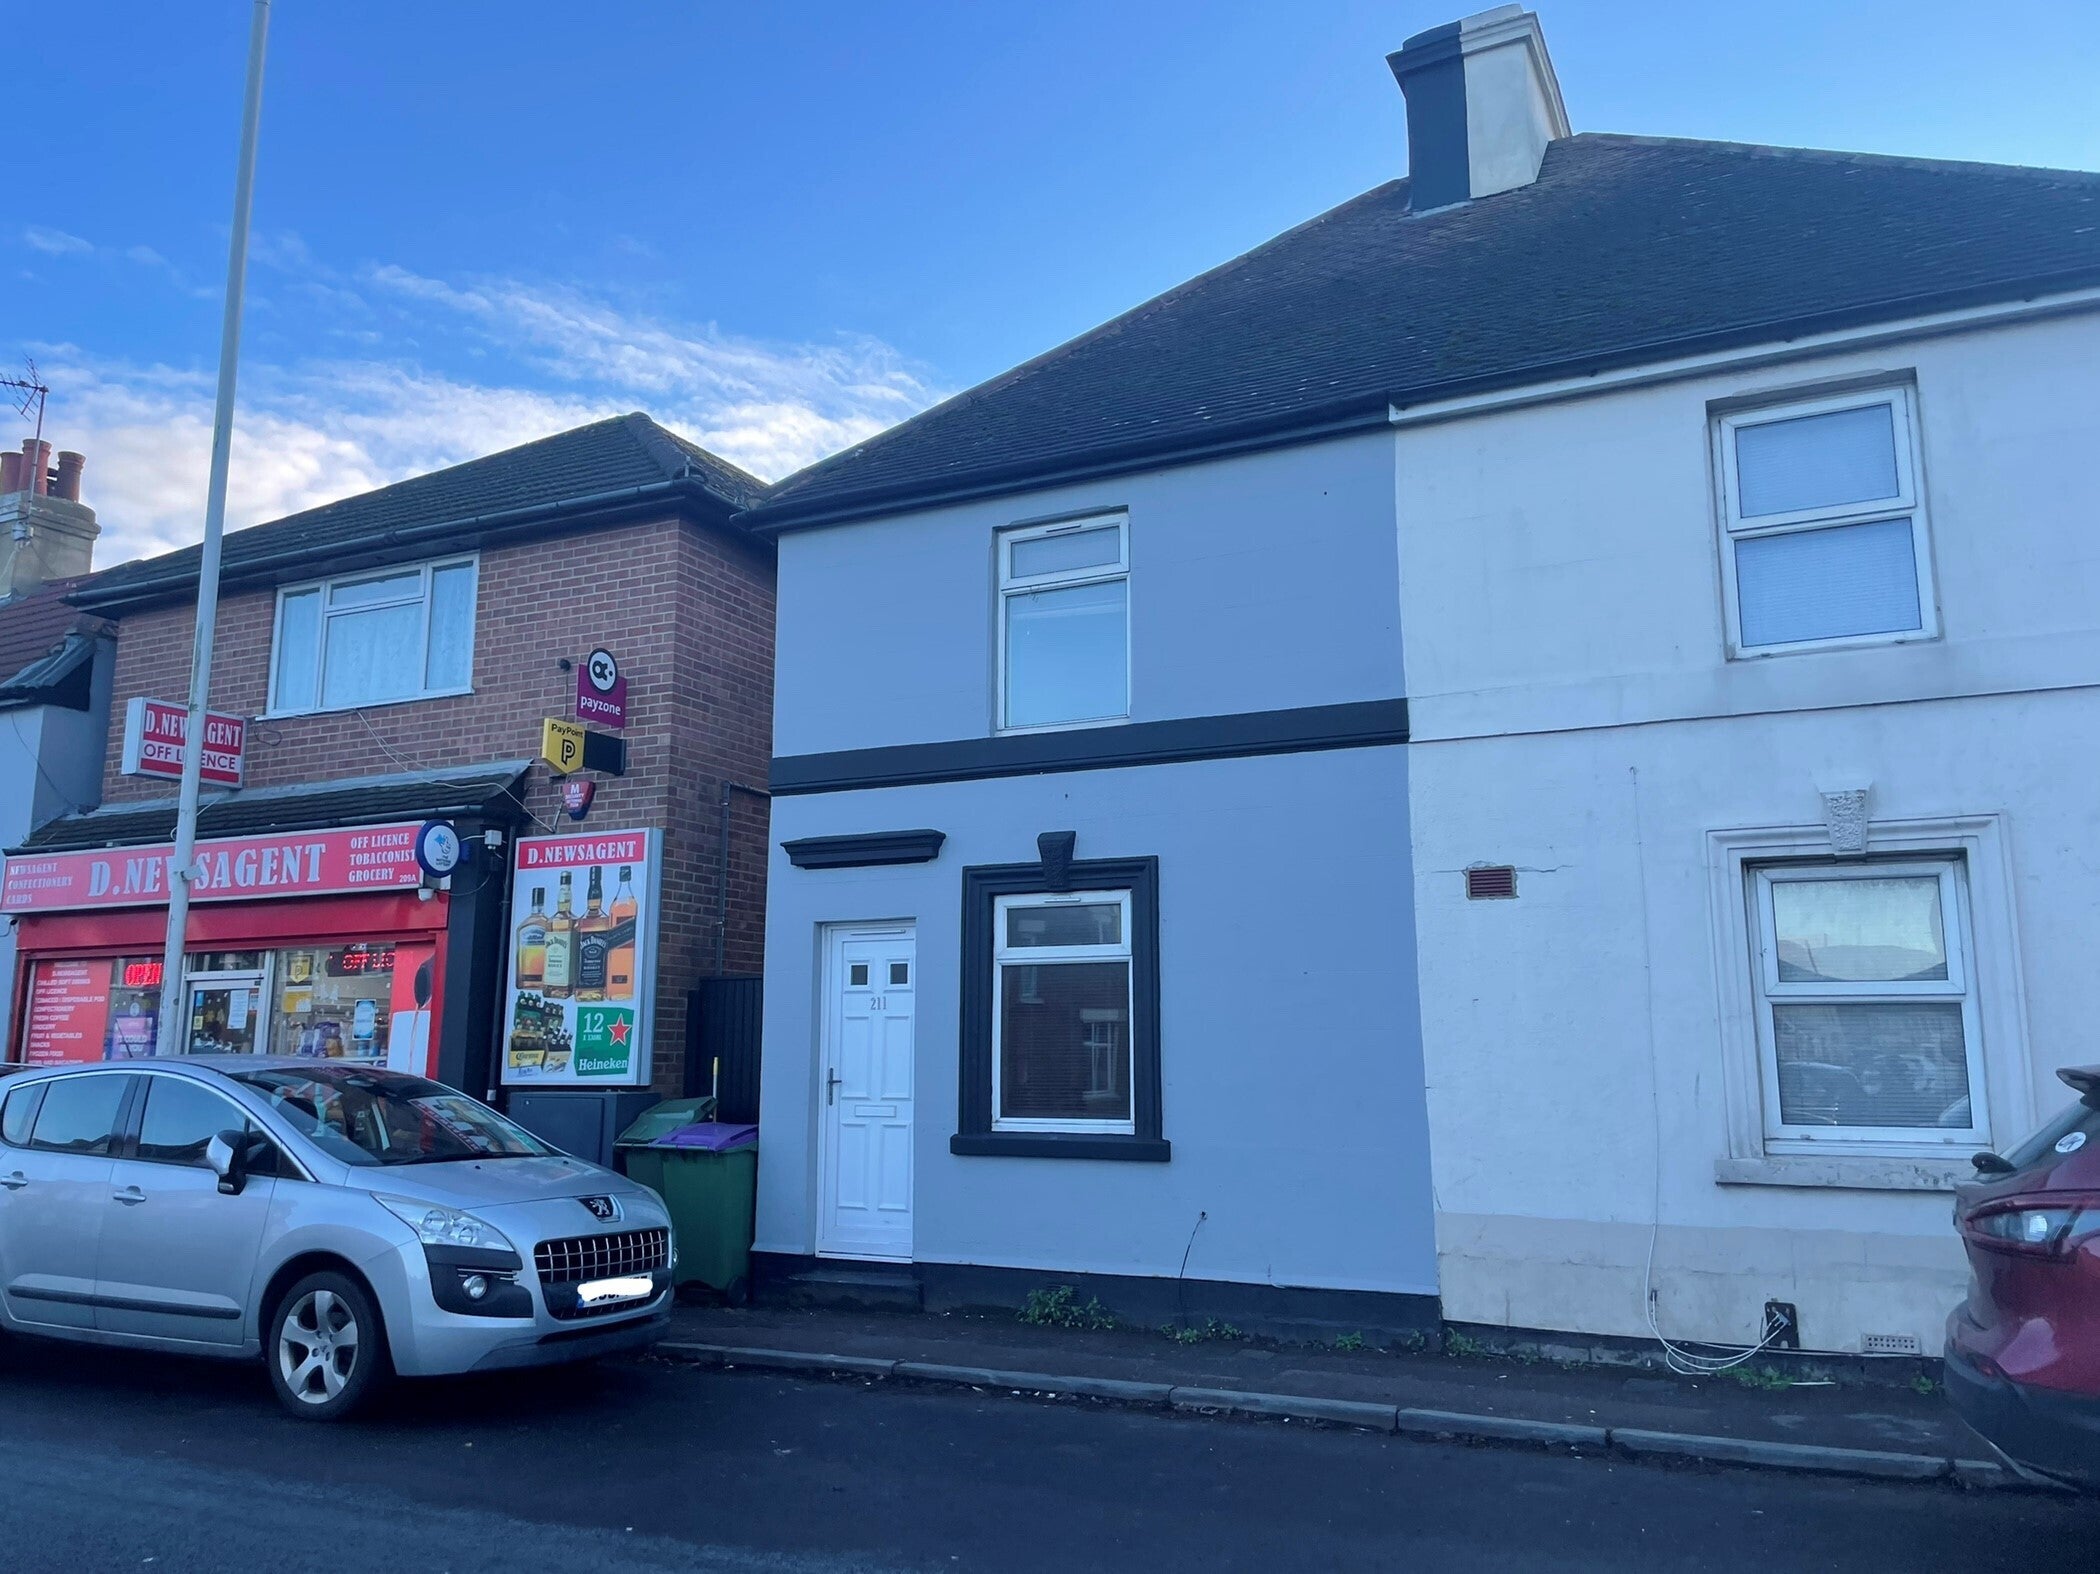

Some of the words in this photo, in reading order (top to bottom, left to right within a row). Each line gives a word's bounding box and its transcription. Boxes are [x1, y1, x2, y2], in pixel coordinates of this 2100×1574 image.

[580, 695, 622, 716] payzone
[551, 723, 584, 739] PayPoint
[144, 744, 172, 760] OFF
[561, 739, 576, 766] P
[350, 836, 369, 849] OFF
[371, 833, 410, 847] LICENCE
[349, 849, 416, 866] TOBACCONIST
[527, 840, 637, 865] D.NEWSAGENT
[9, 863, 58, 876] NEWSAGENT
[87, 843, 326, 898] D.NESAGENT
[348, 868, 395, 883] GROCERY
[8, 876, 73, 889] CONFECTIONERY
[399, 874, 417, 883] 209A
[6, 894, 32, 904] CARDS
[125, 963, 163, 986] OPEN
[870, 996, 887, 1010] 211
[583, 1013, 604, 1033] 12
[578, 1057, 628, 1071] Heineken
